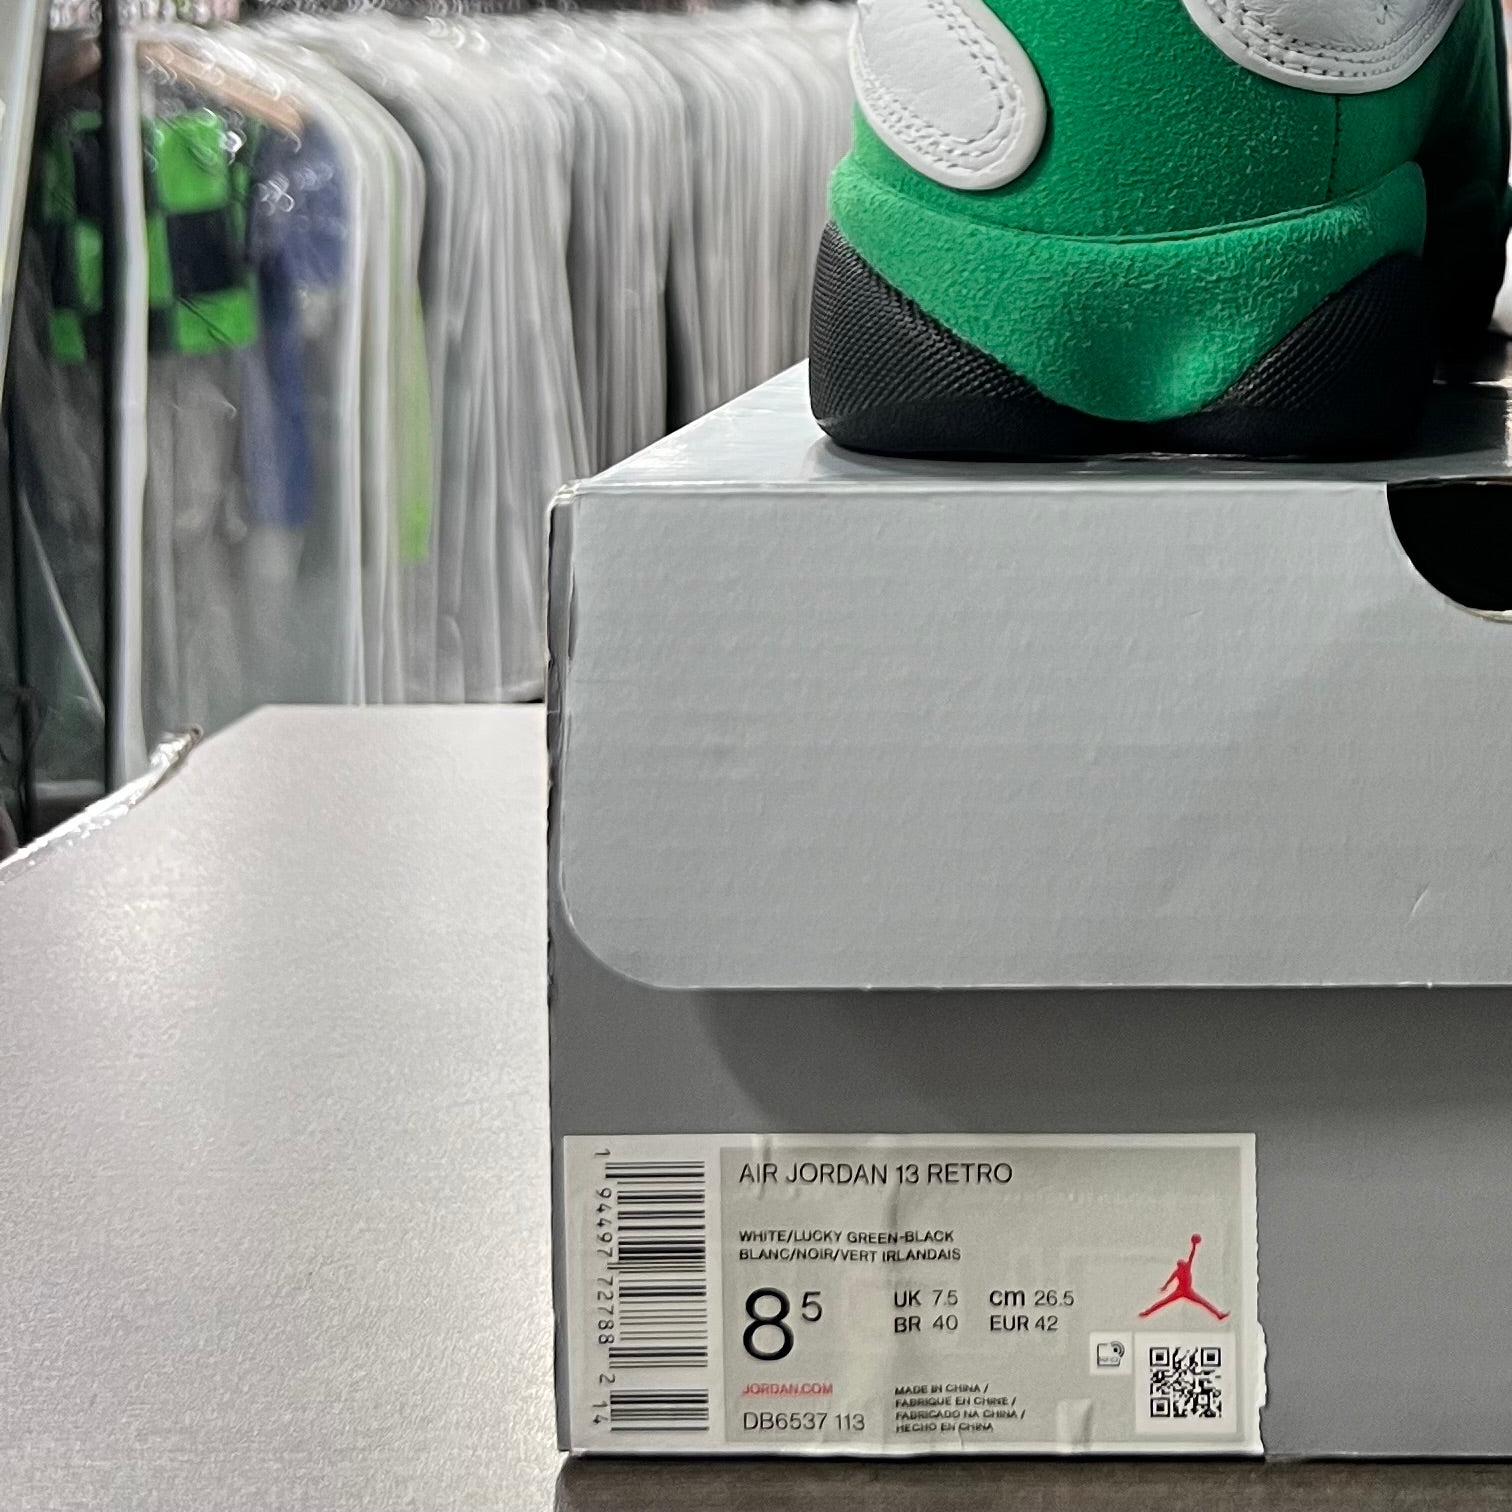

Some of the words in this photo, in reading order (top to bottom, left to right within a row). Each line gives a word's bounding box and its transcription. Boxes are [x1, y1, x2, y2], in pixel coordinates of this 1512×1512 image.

[739, 1163, 778, 1184] AIR
[785, 1163, 887, 1184] JORDAN
[896, 1164, 920, 1184] 13
[927, 1163, 1013, 1184] RETRO
[595, 1187, 613, 1258] 94497
[739, 1230, 842, 1243] WHITE/LUCKY
[847, 1230, 954, 1244] GREEN-BLACK
[739, 1248, 877, 1262] BLANC/NOIR/VERT
[882, 1248, 961, 1262] IRLANDAIS
[894, 1290, 921, 1307] UK
[932, 1289, 959, 1306] 7.5
[989, 1290, 1026, 1306] cm
[1034, 1289, 1075, 1306] 26.5
[597, 1275, 615, 1344] 72788
[743, 1287, 794, 1361] 8
[894, 1316, 921, 1333] BR
[932, 1314, 959, 1331] 40
[990, 1315, 1029, 1331] EUR
[1034, 1315, 1059, 1331] 42
[599, 1373, 616, 1384] 2
[743, 1383, 833, 1395] JORDAN.COM
[895, 1385, 928, 1395] MADE
[931, 1384, 942, 1393] IN
[945, 1384, 981, 1393] CHINA
[955, 1397, 970, 1406] EN
[974, 1397, 1009, 1406] CHINE
[743, 1412, 828, 1432] DB6537
[836, 1413, 865, 1431] 113
[896, 1410, 960, 1420] FABRICADO
[964, 1410, 980, 1419] NA
[983, 1410, 1018, 1419] CHINA
[896, 1423, 937, 1433] HECHO
[940, 1423, 956, 1432] EN
[959, 1423, 994, 1432] CHINA
